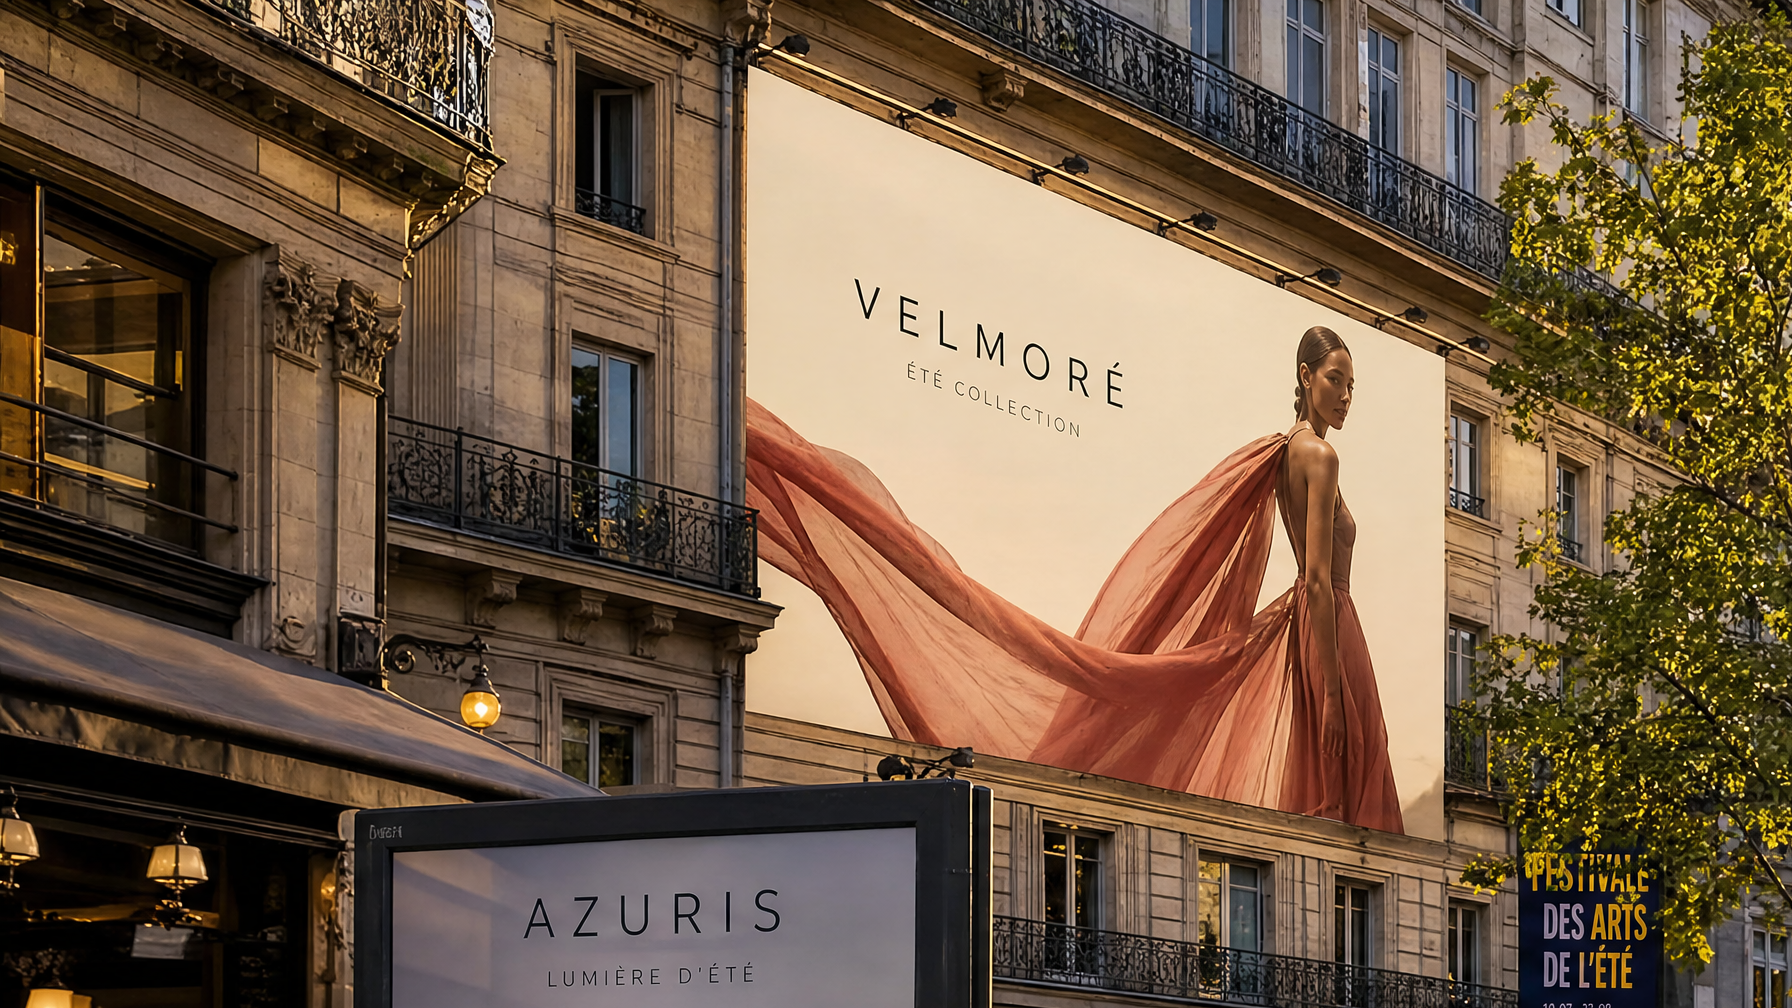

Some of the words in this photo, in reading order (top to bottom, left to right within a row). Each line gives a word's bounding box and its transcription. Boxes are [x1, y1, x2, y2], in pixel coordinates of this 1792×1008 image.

[853, 278, 1124, 409] VELMORÉ
[907, 361, 943, 389] ÉTÉ
[954, 381, 1080, 437] COLLECTION
[523, 889, 781, 939] AZURIS
[1543, 903, 1585, 940] DES
[1590, 903, 1648, 941] ARTS
[547, 965, 661, 988] LUMIÈRE
[679, 962, 754, 984] D'ÉTÉ
[1543, 951, 1571, 988] DE
[1578, 944, 1633, 989] L'ÉTÉ
